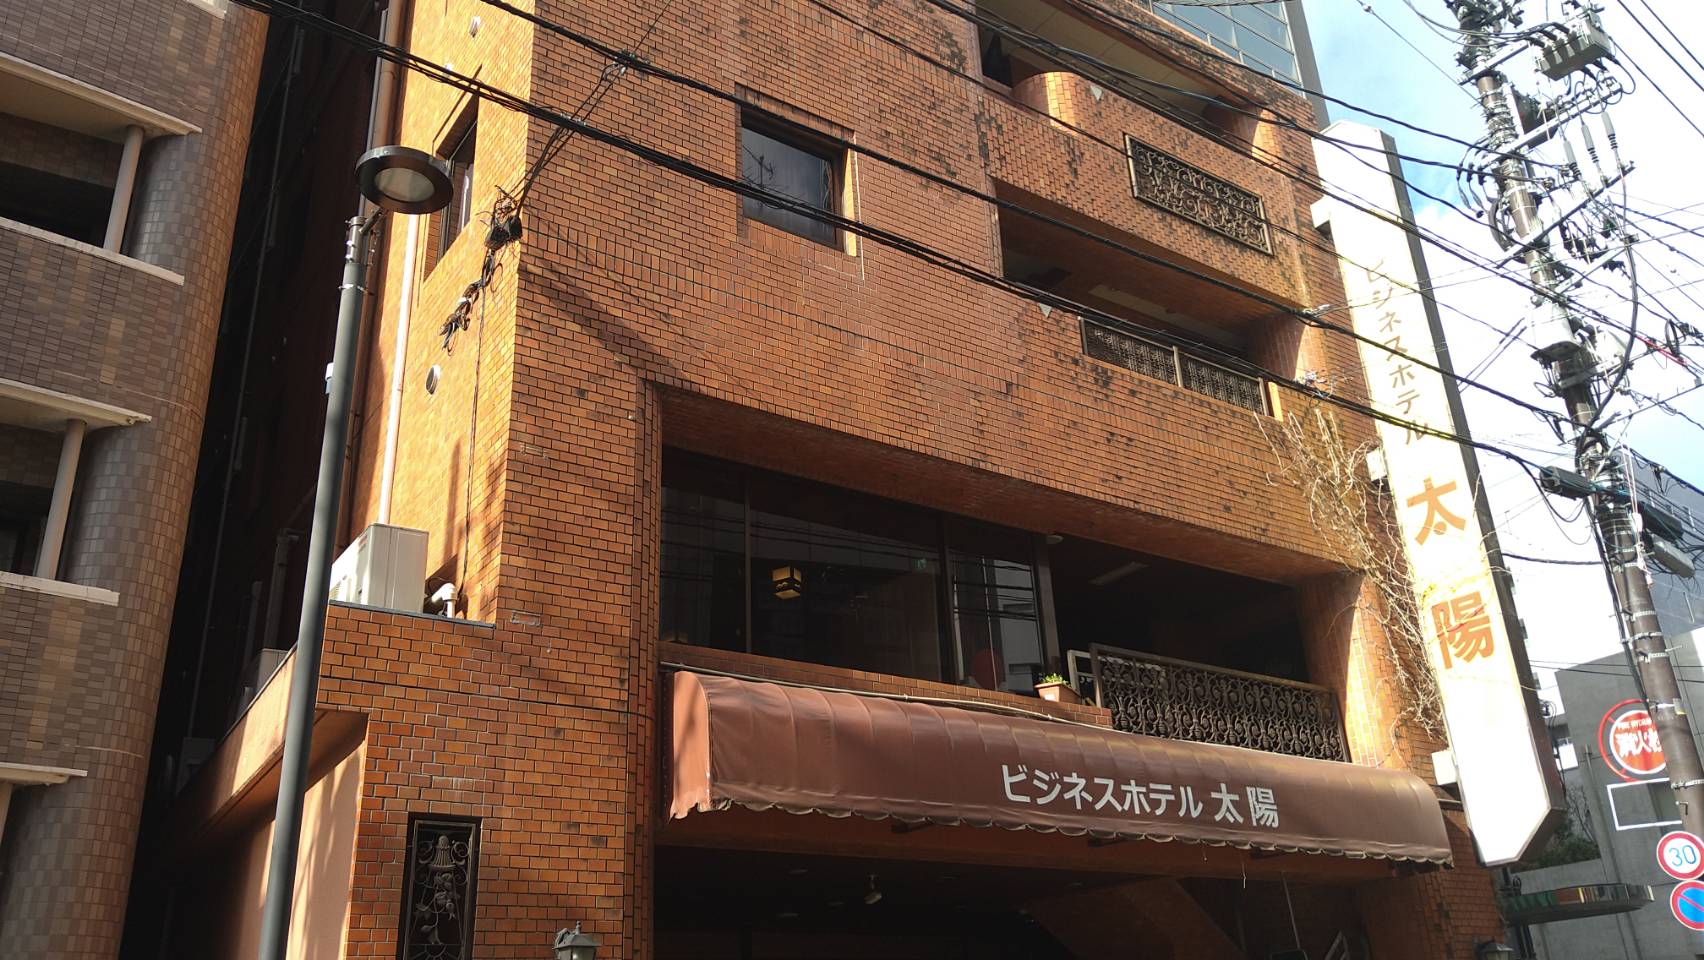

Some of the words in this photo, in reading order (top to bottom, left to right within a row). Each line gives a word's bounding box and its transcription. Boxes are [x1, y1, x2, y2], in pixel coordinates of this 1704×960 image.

[1406, 476, 1495, 670] 太陽
[1001, 764, 1203, 818] ビジネスホテル
[1210, 783, 1279, 828] 太陽
[1669, 845, 1697, 867] 30
